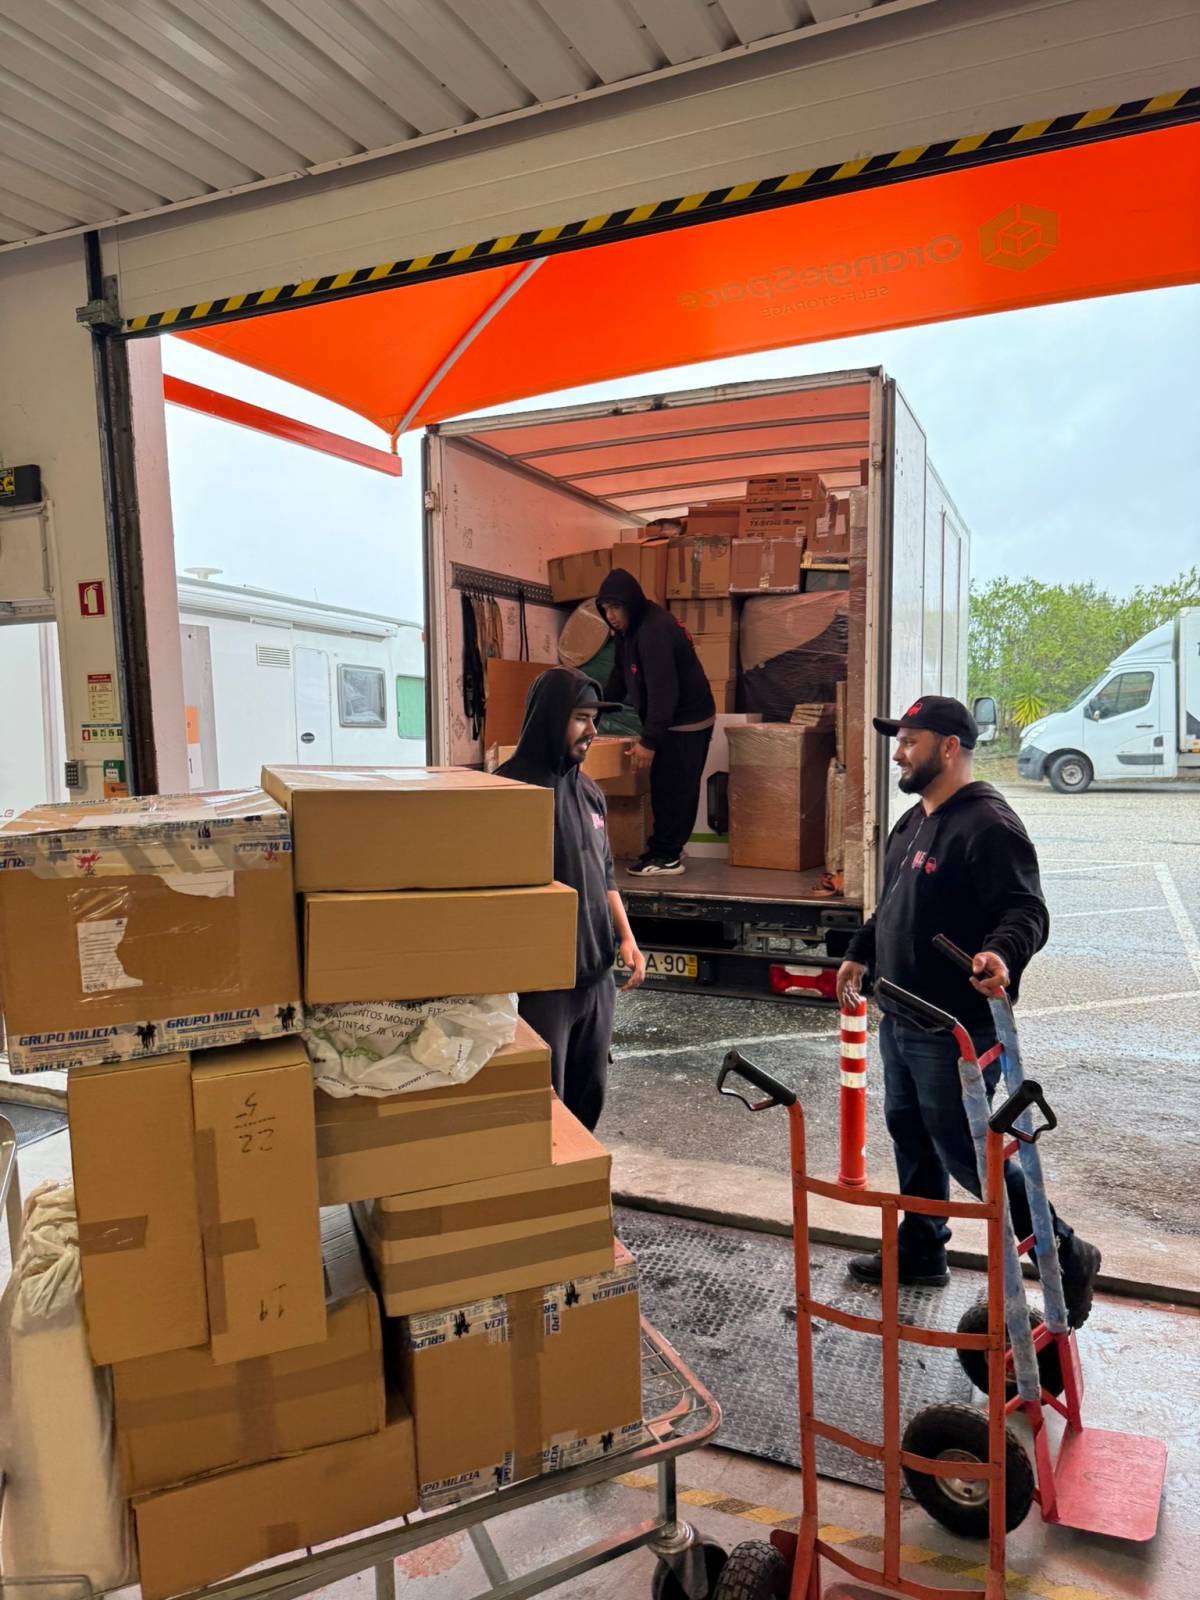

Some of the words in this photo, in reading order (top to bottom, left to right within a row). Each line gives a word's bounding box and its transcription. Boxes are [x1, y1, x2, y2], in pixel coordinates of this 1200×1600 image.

[167, 1014, 211, 1029] GRUPO
[213, 1008, 260, 1023] MILICIA
[19, 1032, 66, 1047] GRUPO
[67, 1026, 119, 1042] MILICIA
